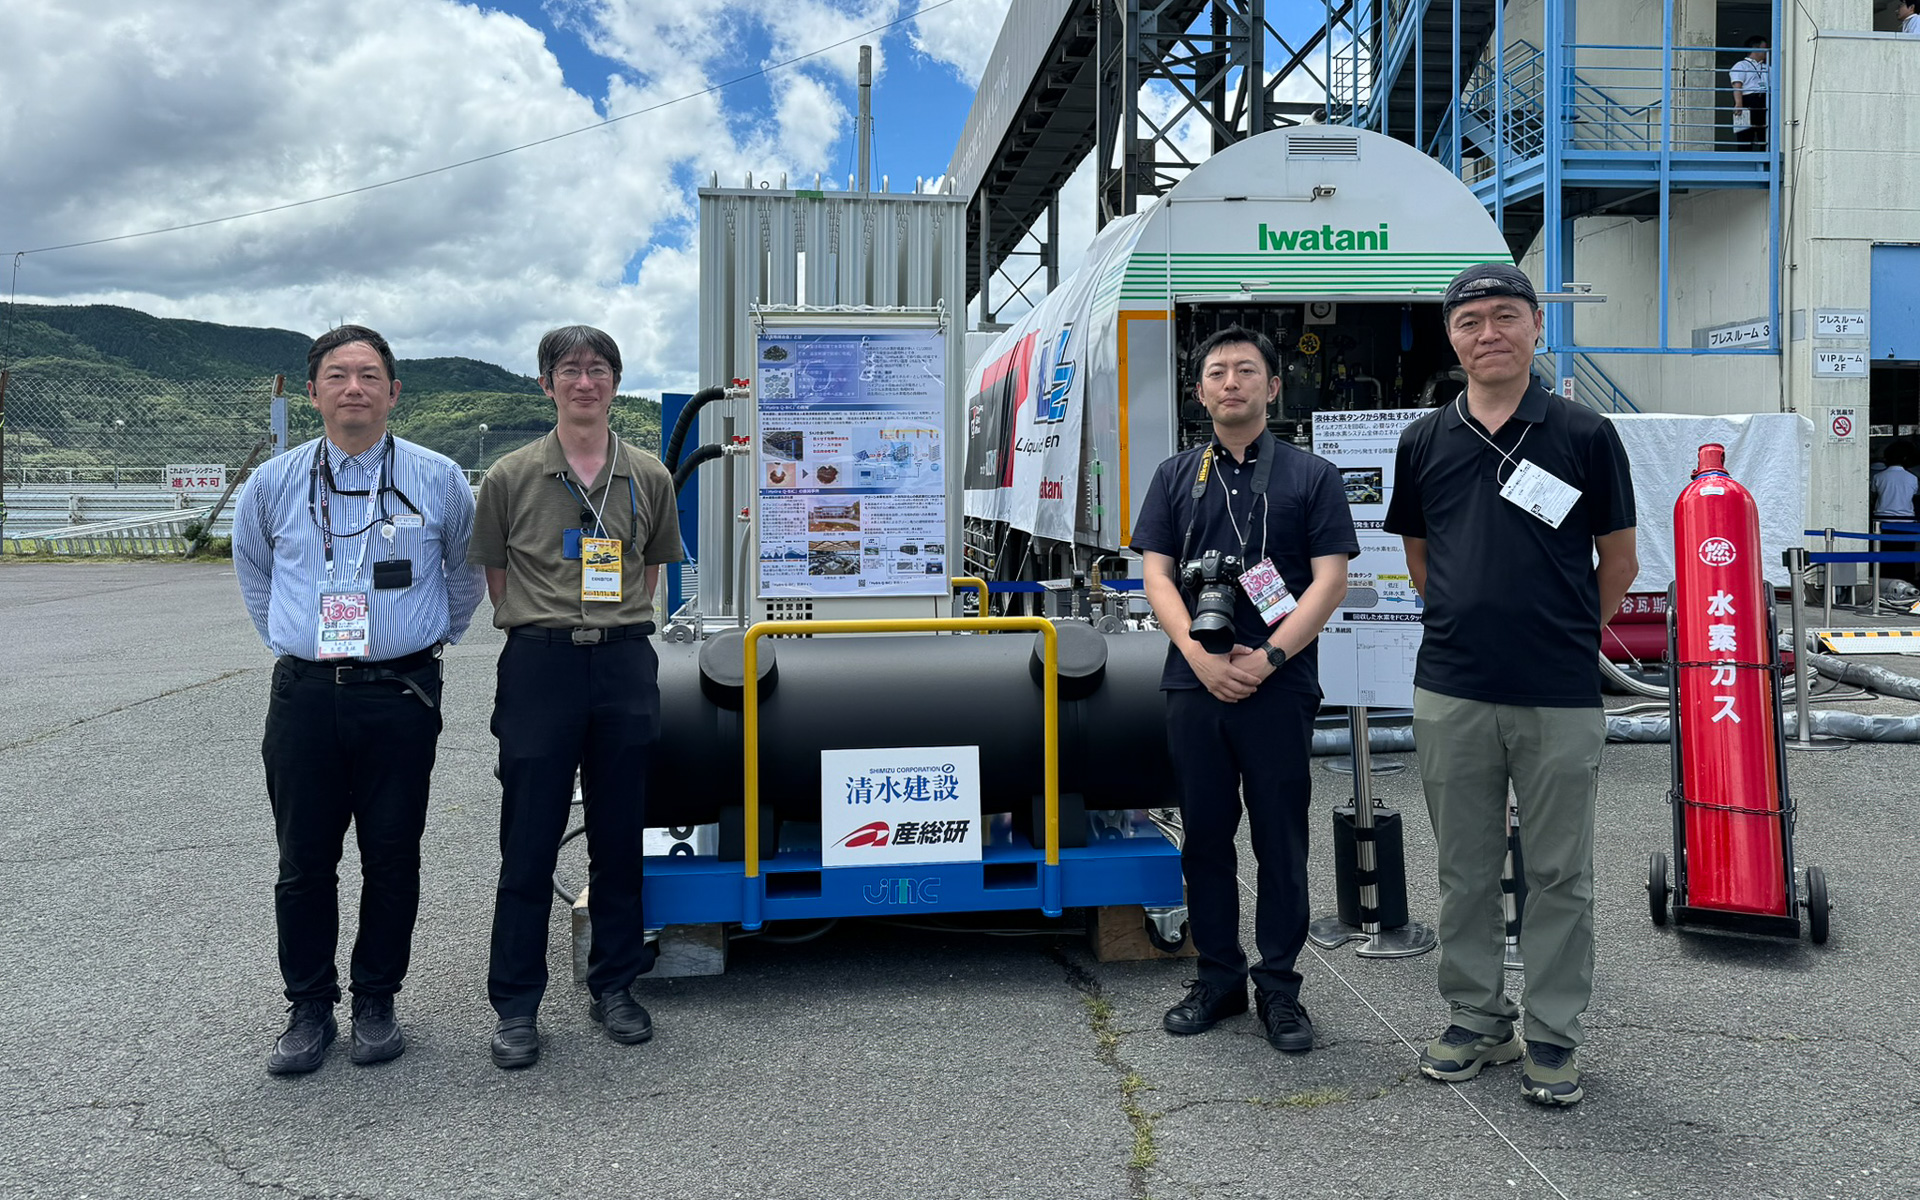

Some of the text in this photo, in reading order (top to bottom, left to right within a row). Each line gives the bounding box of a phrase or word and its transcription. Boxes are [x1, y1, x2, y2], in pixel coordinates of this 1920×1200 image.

[1258, 223, 1388, 251] Iwatani
[1818, 315, 1864, 324] プレスルーム
[1711, 327, 1759, 345] プレスルーム
[1835, 325, 1848, 333] 3F
[1820, 354, 1863, 363] VIPルーム
[1834, 364, 1847, 372] 2F
[171, 477, 220, 488] 進入不可
[1615, 596, 1667, 614] 谷瓦斯
[1706, 590, 1741, 724] 水素ガス
[896, 765, 941, 773] CORPORATION
[845, 774, 959, 805] 清水建設
[891, 820, 971, 846] 産総研
